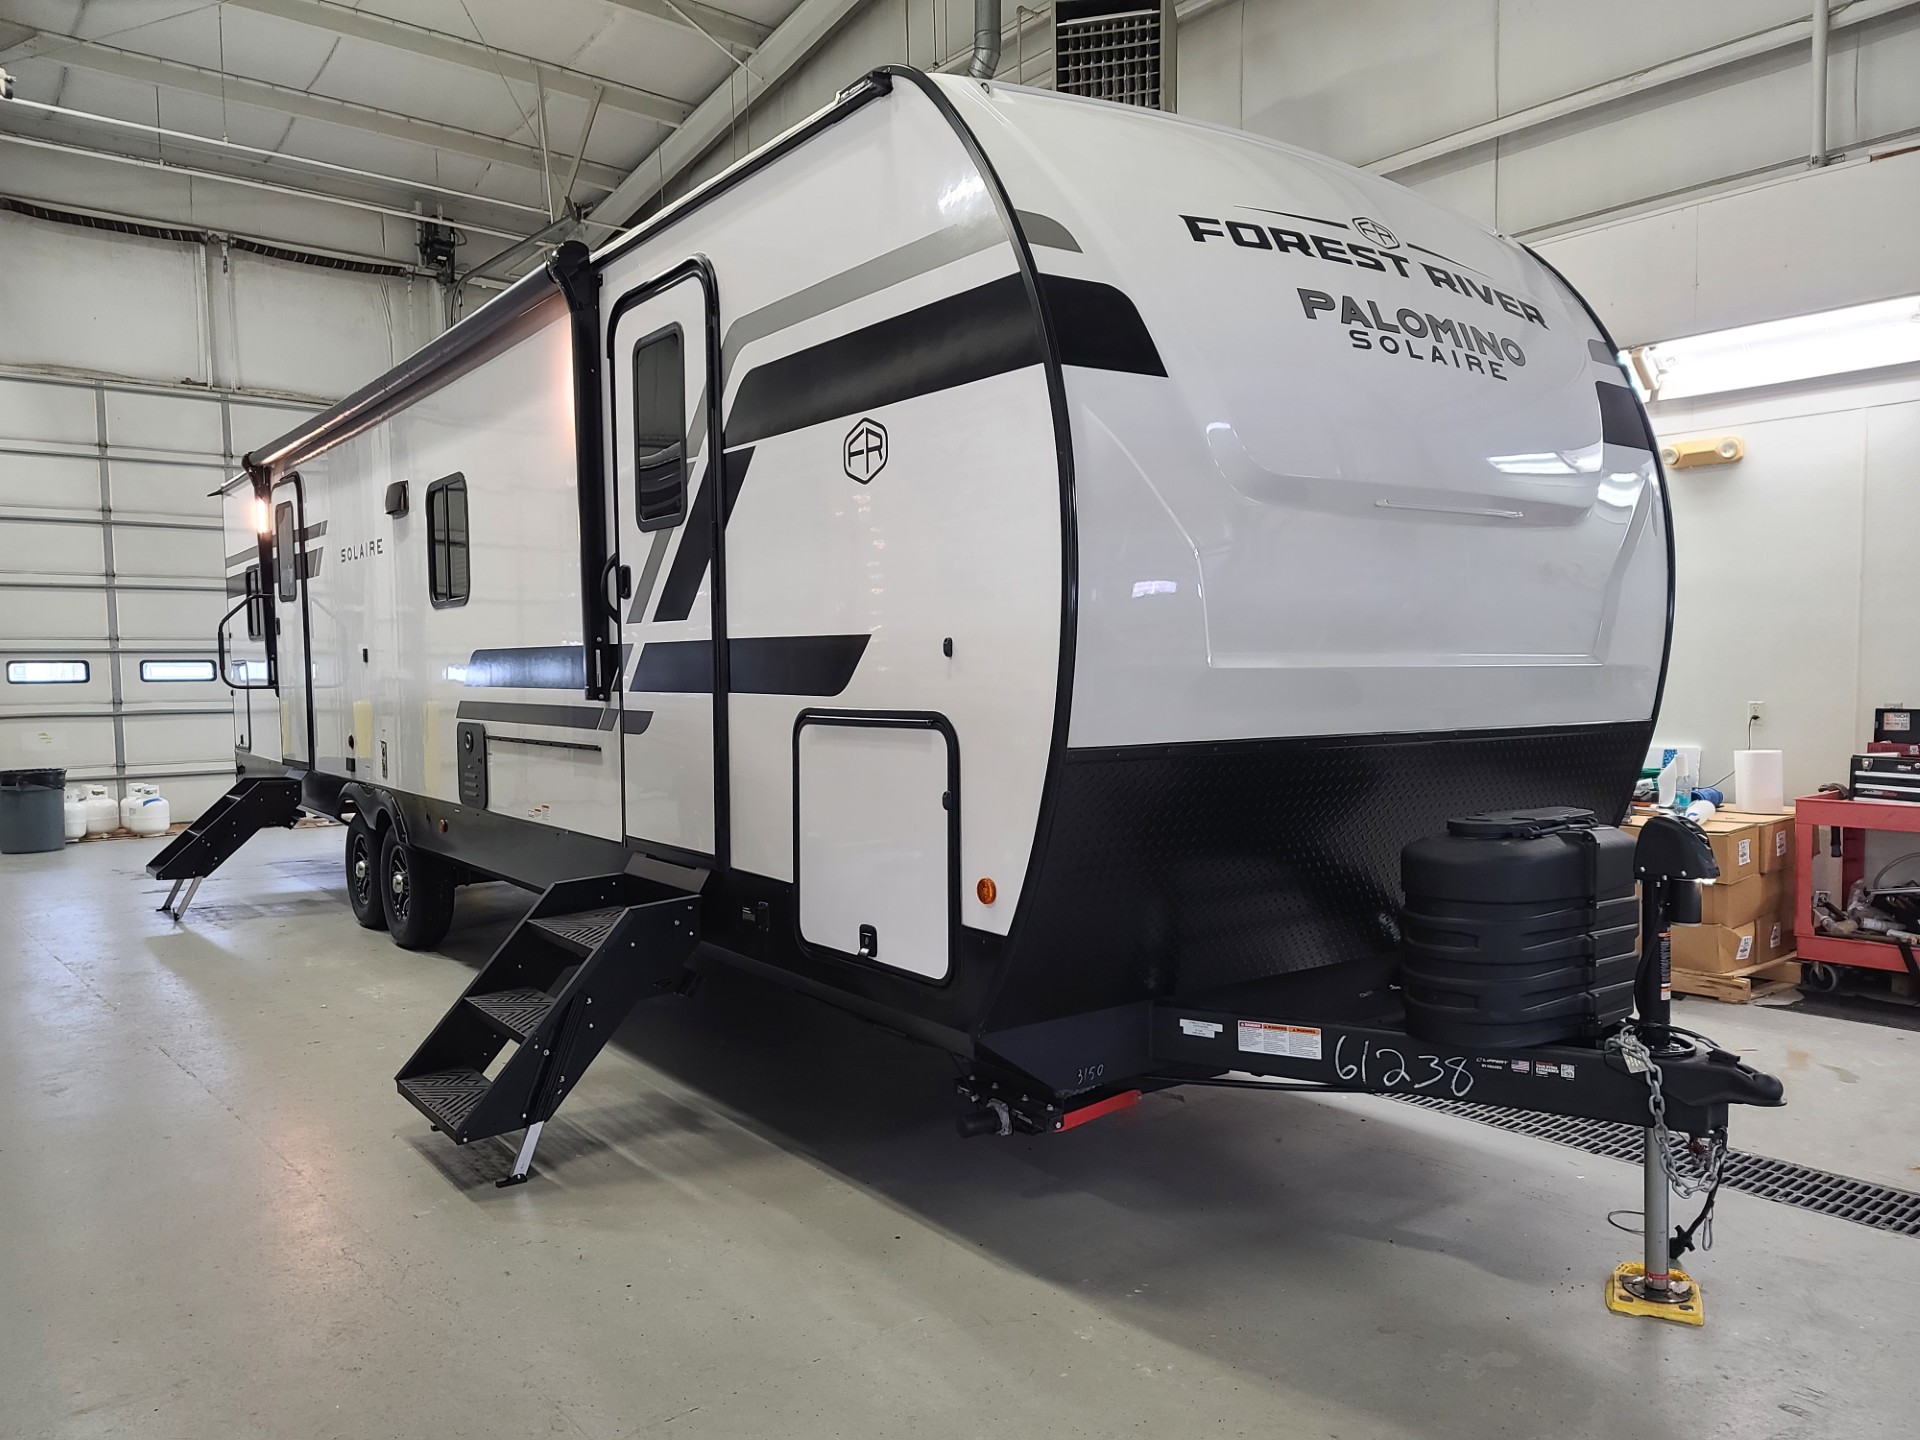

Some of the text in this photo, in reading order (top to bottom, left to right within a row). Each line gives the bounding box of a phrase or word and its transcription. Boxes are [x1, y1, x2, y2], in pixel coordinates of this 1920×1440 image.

[1178, 214, 1550, 330] FOREST RIVER
[1296, 287, 1526, 367] PALOMINO
[1349, 329, 1508, 381] SOLAIRE
[342, 538, 383, 563] SOLAIRE
[1077, 1063, 1105, 1085] 3150
[1335, 1035, 1474, 1096] 61238
